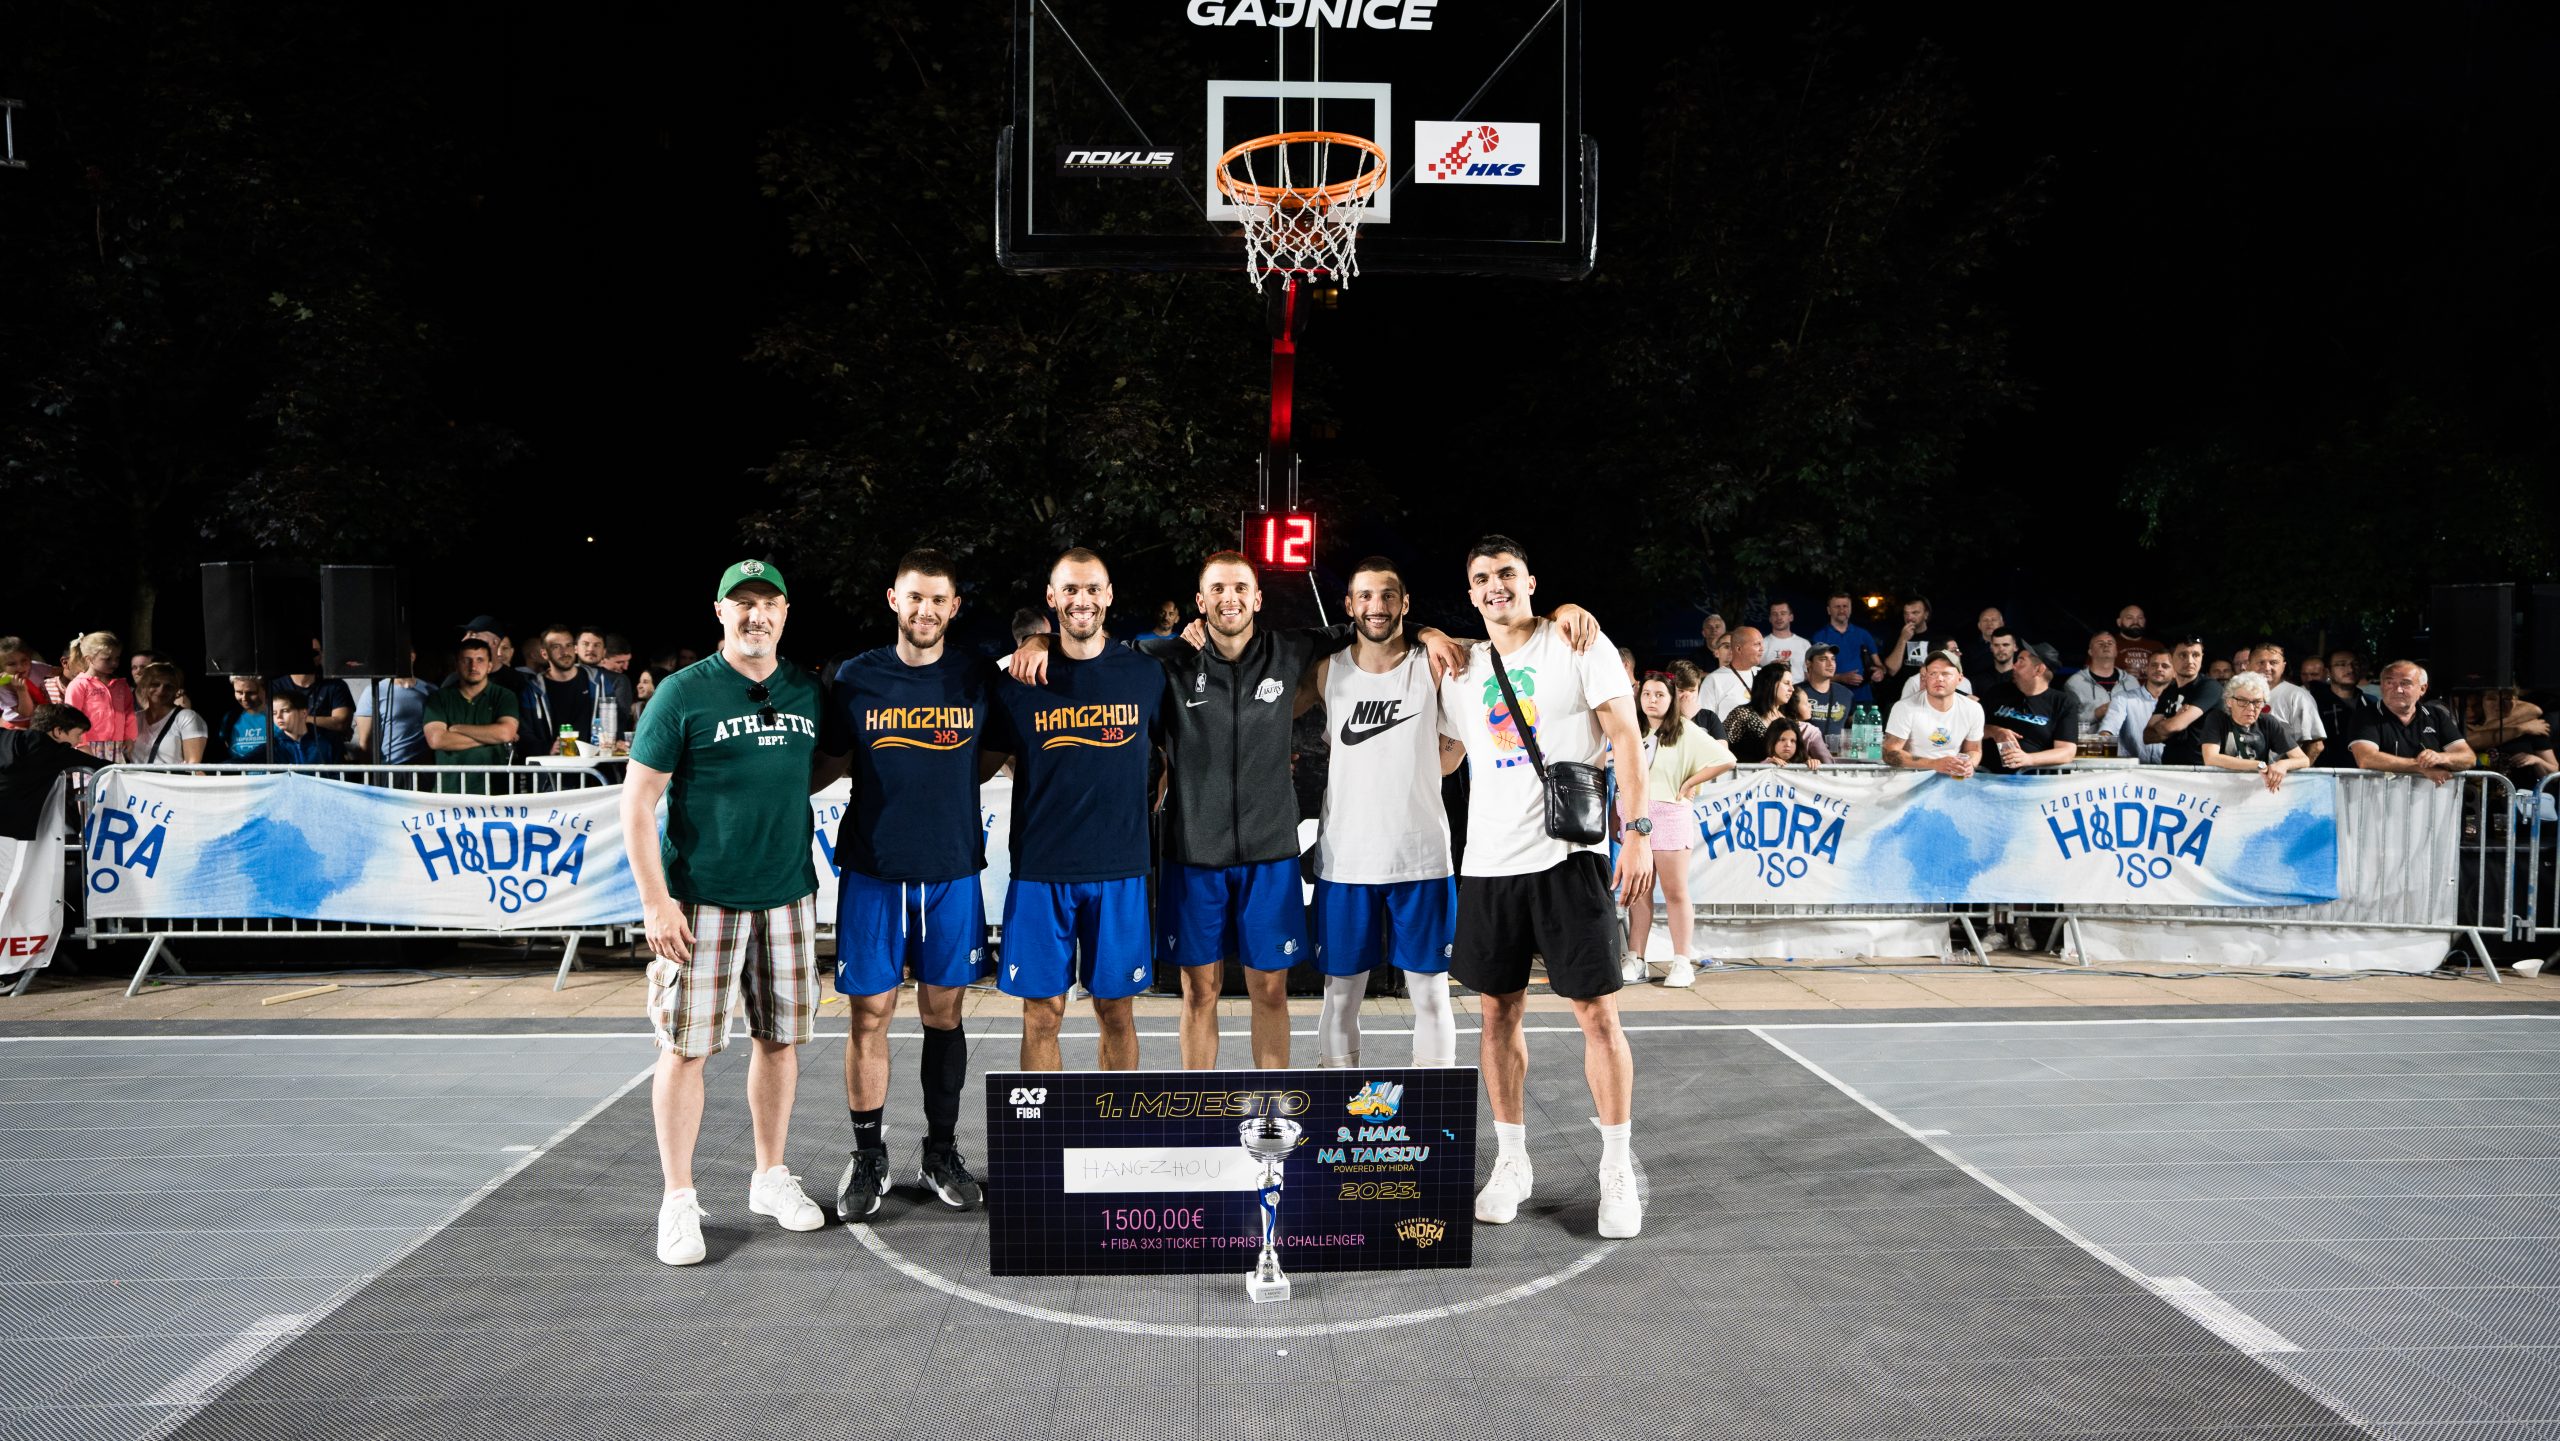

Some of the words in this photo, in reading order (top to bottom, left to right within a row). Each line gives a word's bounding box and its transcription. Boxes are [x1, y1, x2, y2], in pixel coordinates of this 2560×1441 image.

[1186, 0, 1438, 31] GAJNICE
[1064, 151, 1175, 165] NOVUS
[1465, 163, 1526, 178] HKS
[1266, 518, 1312, 563] 12
[865, 707, 974, 731] HANGZHOU
[1035, 704, 1139, 732] HANGZHOU
[1350, 699, 1402, 725] NIKE
[757, 736, 788, 747] DEPT.
[933, 730, 958, 744] 3X3
[1101, 727, 1124, 741] 3X3
[126, 794, 175, 825] PIĆE
[1812, 792, 1851, 818] PIĆE
[2178, 793, 2223, 819] PIĆE
[547, 810, 594, 833] PIĆE
[1016, 1107, 1041, 1119] FIBA
[1095, 1092, 1123, 1118] 1.
[1130, 1090, 1311, 1118] MJESTO
[1337, 1126, 1354, 1143] 9.
[1358, 1126, 1411, 1142] HAKL
[1317, 1148, 1346, 1164] NA
[1351, 1146, 1430, 1163] TAKSIJU
[1083, 1157, 1222, 1181] HANGZHOU
[1333, 1164, 1375, 1173] POWERED
[1376, 1164, 1388, 1172] BY
[1389, 1163, 1415, 1172] HIDRA
[1337, 1181, 1421, 1200] 2023.
[1101, 1208, 1204, 1233] 1500,00€
[1111, 1238, 1138, 1250] FIBA
[1140, 1237, 1163, 1249] 3X3
[1167, 1237, 1208, 1249] TICKET
[1210, 1236, 1226, 1249] TO
[1229, 1235, 1285, 1248] PRISTA
[1287, 1234, 1365, 1247] CHALLENGER
